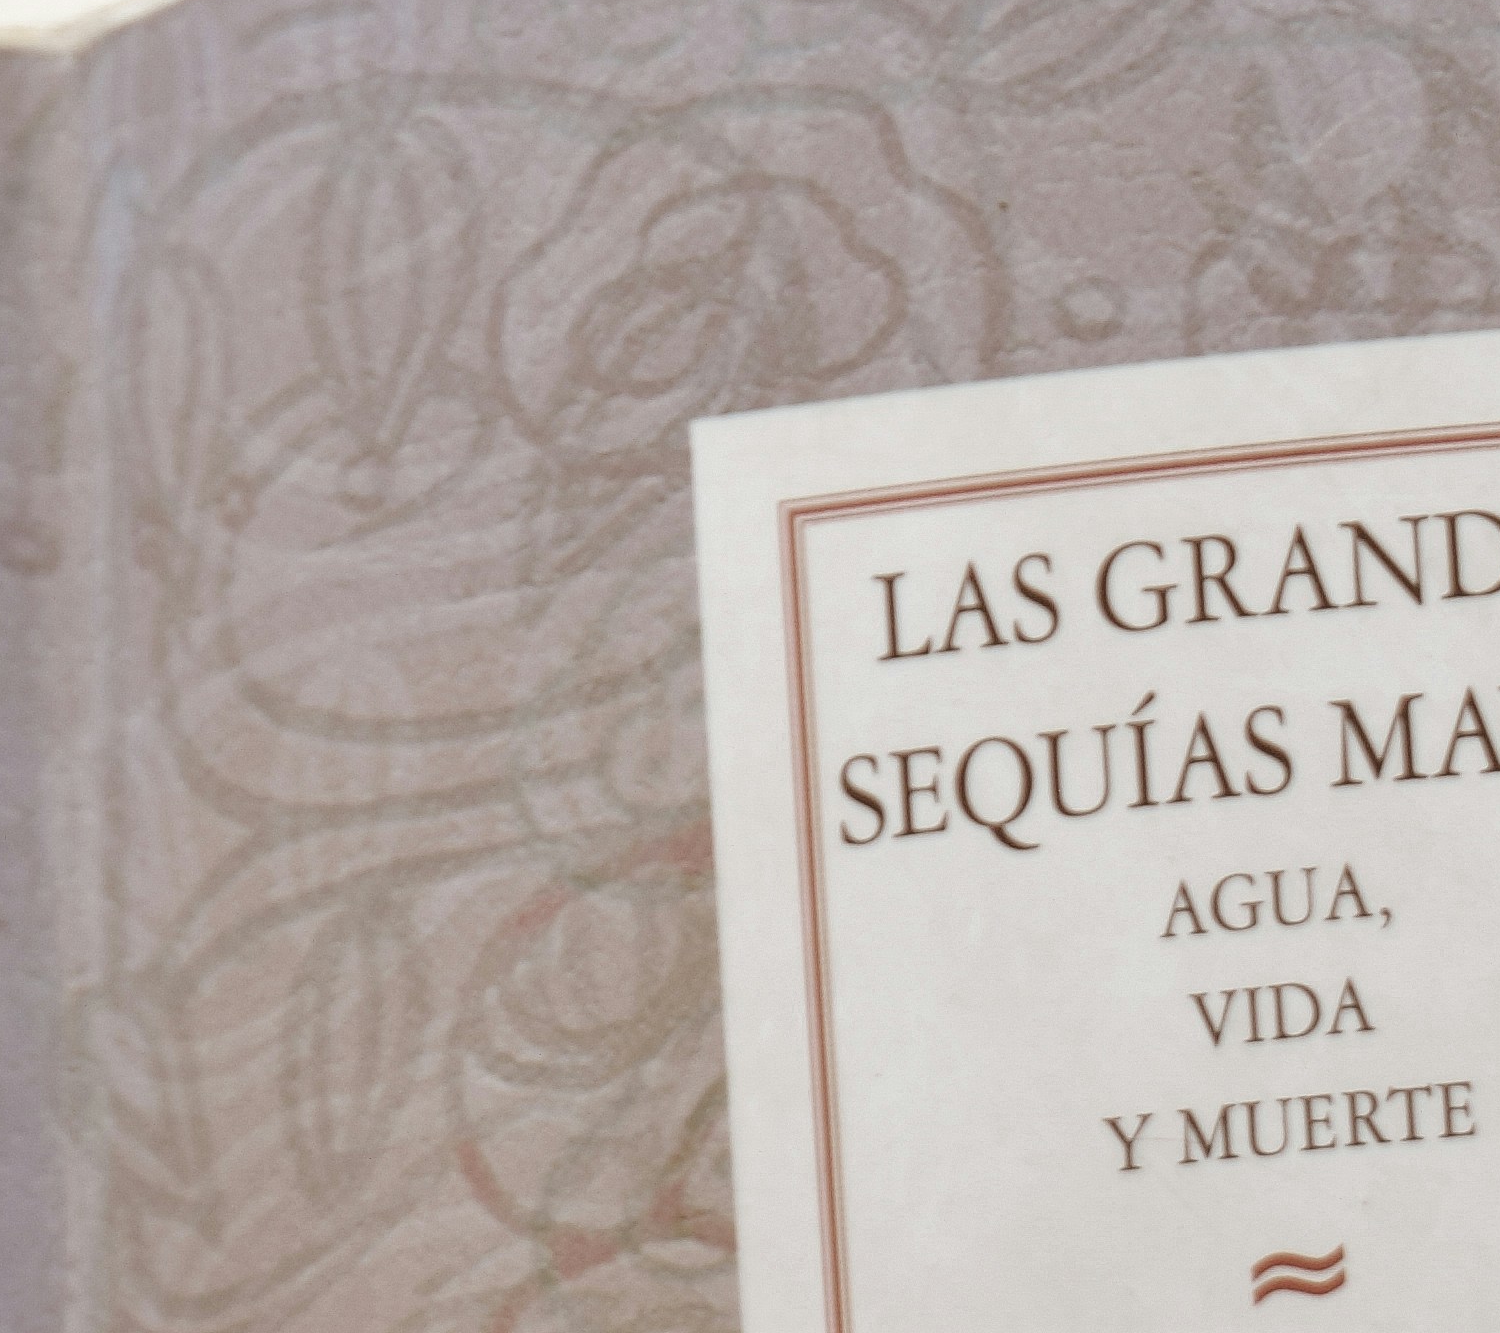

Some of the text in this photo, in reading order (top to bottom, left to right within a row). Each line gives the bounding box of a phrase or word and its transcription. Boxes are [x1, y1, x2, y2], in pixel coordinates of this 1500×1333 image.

[872, 552, 1062, 663] LAS
[838, 690, 1296, 854] SEQUÍAS
[1160, 864, 1394, 940] AGUA,
[1188, 978, 1377, 1049] VIDA
[1102, 1080, 1479, 1175] Y MUERTE
